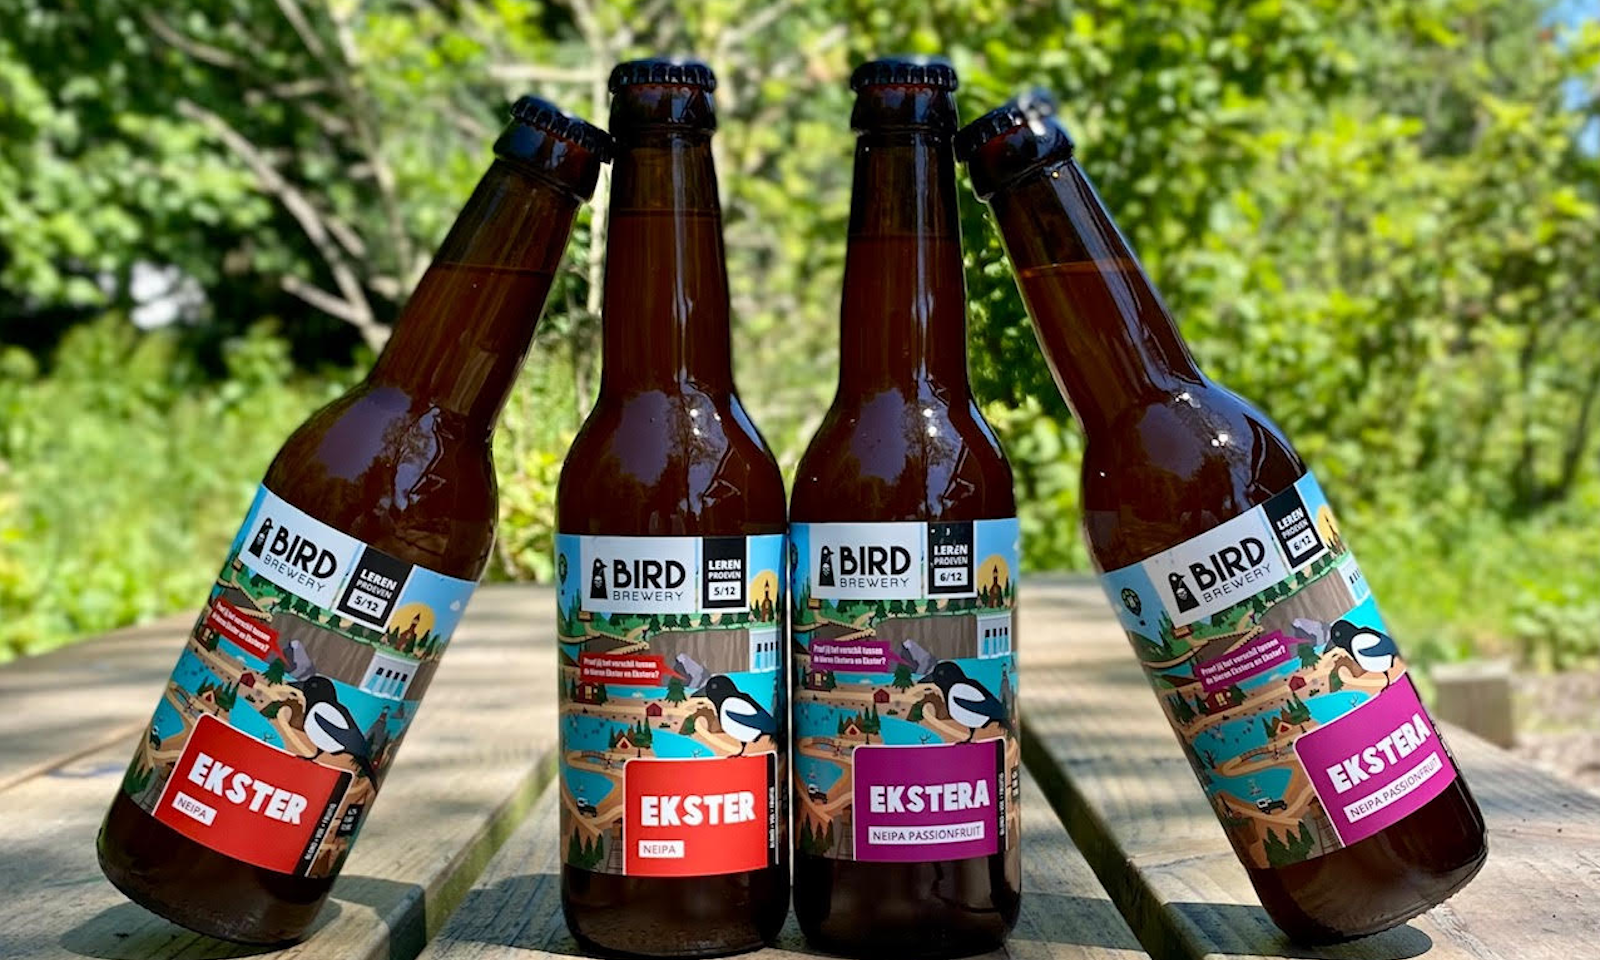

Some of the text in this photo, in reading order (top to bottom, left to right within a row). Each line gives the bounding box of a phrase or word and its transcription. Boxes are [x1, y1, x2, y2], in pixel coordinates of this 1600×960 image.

[1276, 507, 1304, 530] LEREN
[270, 526, 338, 579] BIRD
[934, 544, 968, 556] LEREN
[1293, 535, 1312, 551] 6/12
[708, 559, 741, 570] LEREN
[840, 546, 910, 575] BIRD
[934, 556, 968, 566] PROEVEN
[1189, 537, 1265, 591] BIRD
[264, 555, 326, 593] BREWERY
[360, 568, 398, 590] LEREN
[614, 560, 686, 588] BIRD
[708, 571, 741, 580] PROEVEN
[840, 578, 910, 588] BREWERY
[940, 572, 962, 582] 6/12
[1203, 564, 1272, 603] BREWERY
[356, 579, 393, 600] PROEVEN
[613, 590, 684, 602] BREWERY
[714, 586, 736, 596] 5/12
[354, 594, 379, 613] 5/12
[1326, 713, 1431, 794] EKSTERA
[187, 752, 308, 824] EKSTER
[870, 780, 990, 812] EKSTERA
[1350, 758, 1438, 818] NEIPA PASSIONFRUIT
[176, 796, 208, 820] NEIPA
[641, 791, 756, 826] EKSTER
[873, 826, 982, 840] NEIPA PASSIONFRUIT
[643, 845, 676, 854] NEIPA
